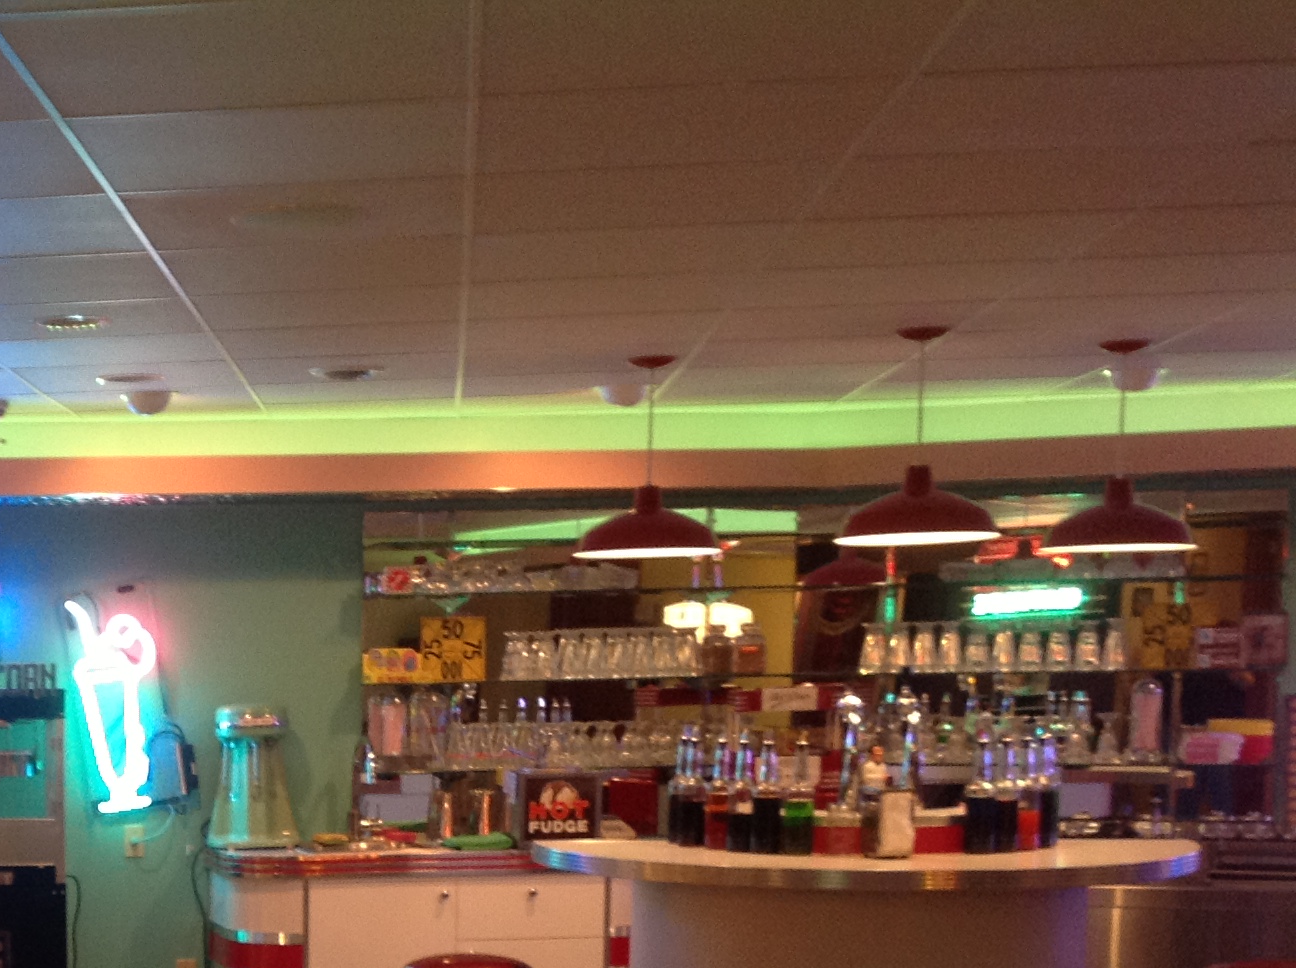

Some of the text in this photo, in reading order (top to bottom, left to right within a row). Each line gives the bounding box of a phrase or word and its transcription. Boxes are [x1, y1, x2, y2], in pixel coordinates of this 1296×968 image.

[442, 620, 463, 639] 50
[424, 639, 442, 660] 25
[528, 800, 590, 820] HOT
[528, 820, 589, 834] FUDGE
